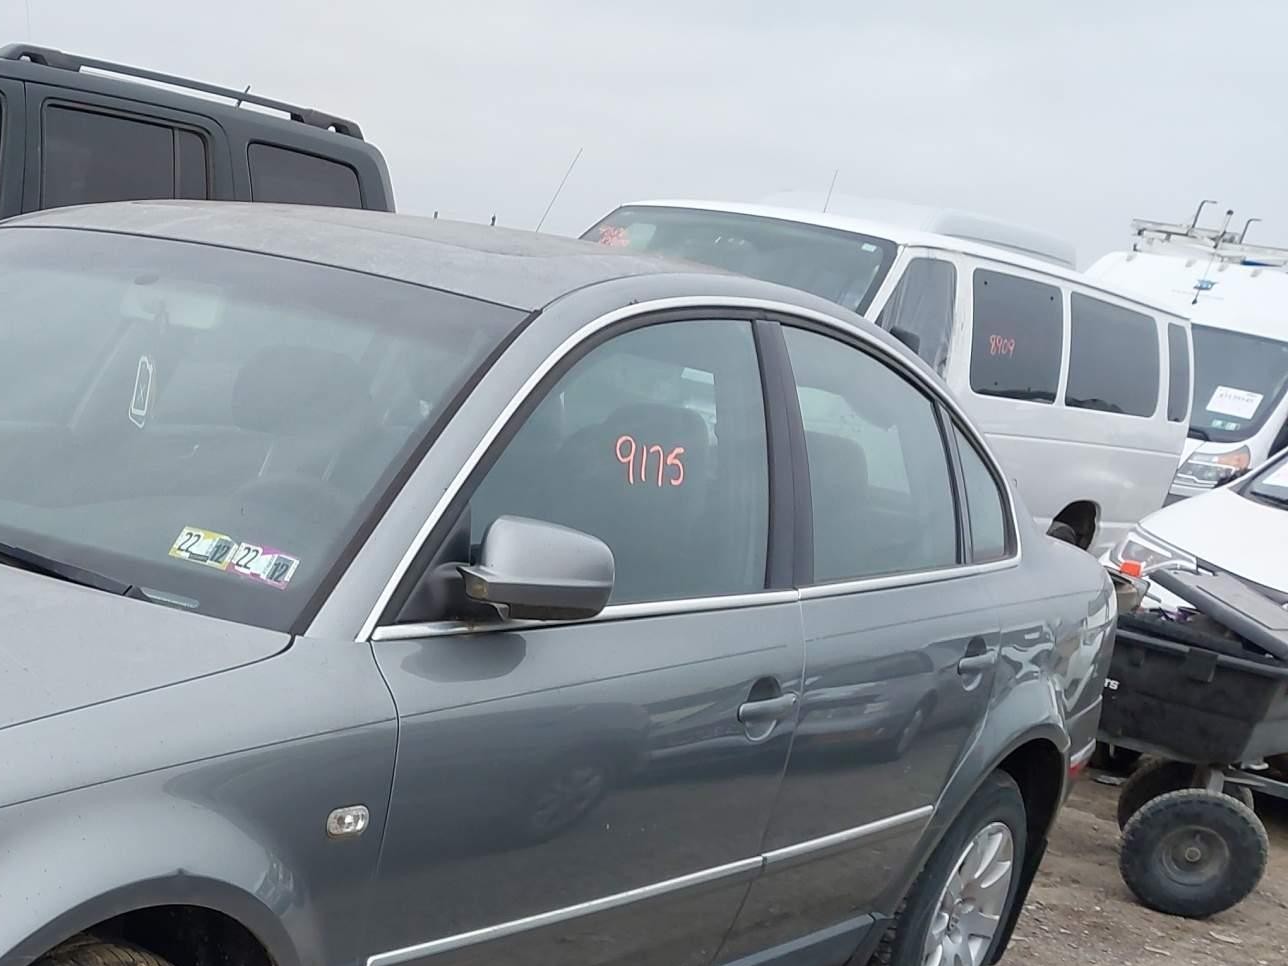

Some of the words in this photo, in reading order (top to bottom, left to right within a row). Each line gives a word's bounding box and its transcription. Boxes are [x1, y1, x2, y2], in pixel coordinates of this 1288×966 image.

[989, 334, 1016, 358] 8909
[615, 434, 685, 488] 9175
[177, 532, 201, 552] 22
[210, 544, 231, 563] 12
[236, 546, 259, 570] 22
[267, 562, 289, 583] 12
